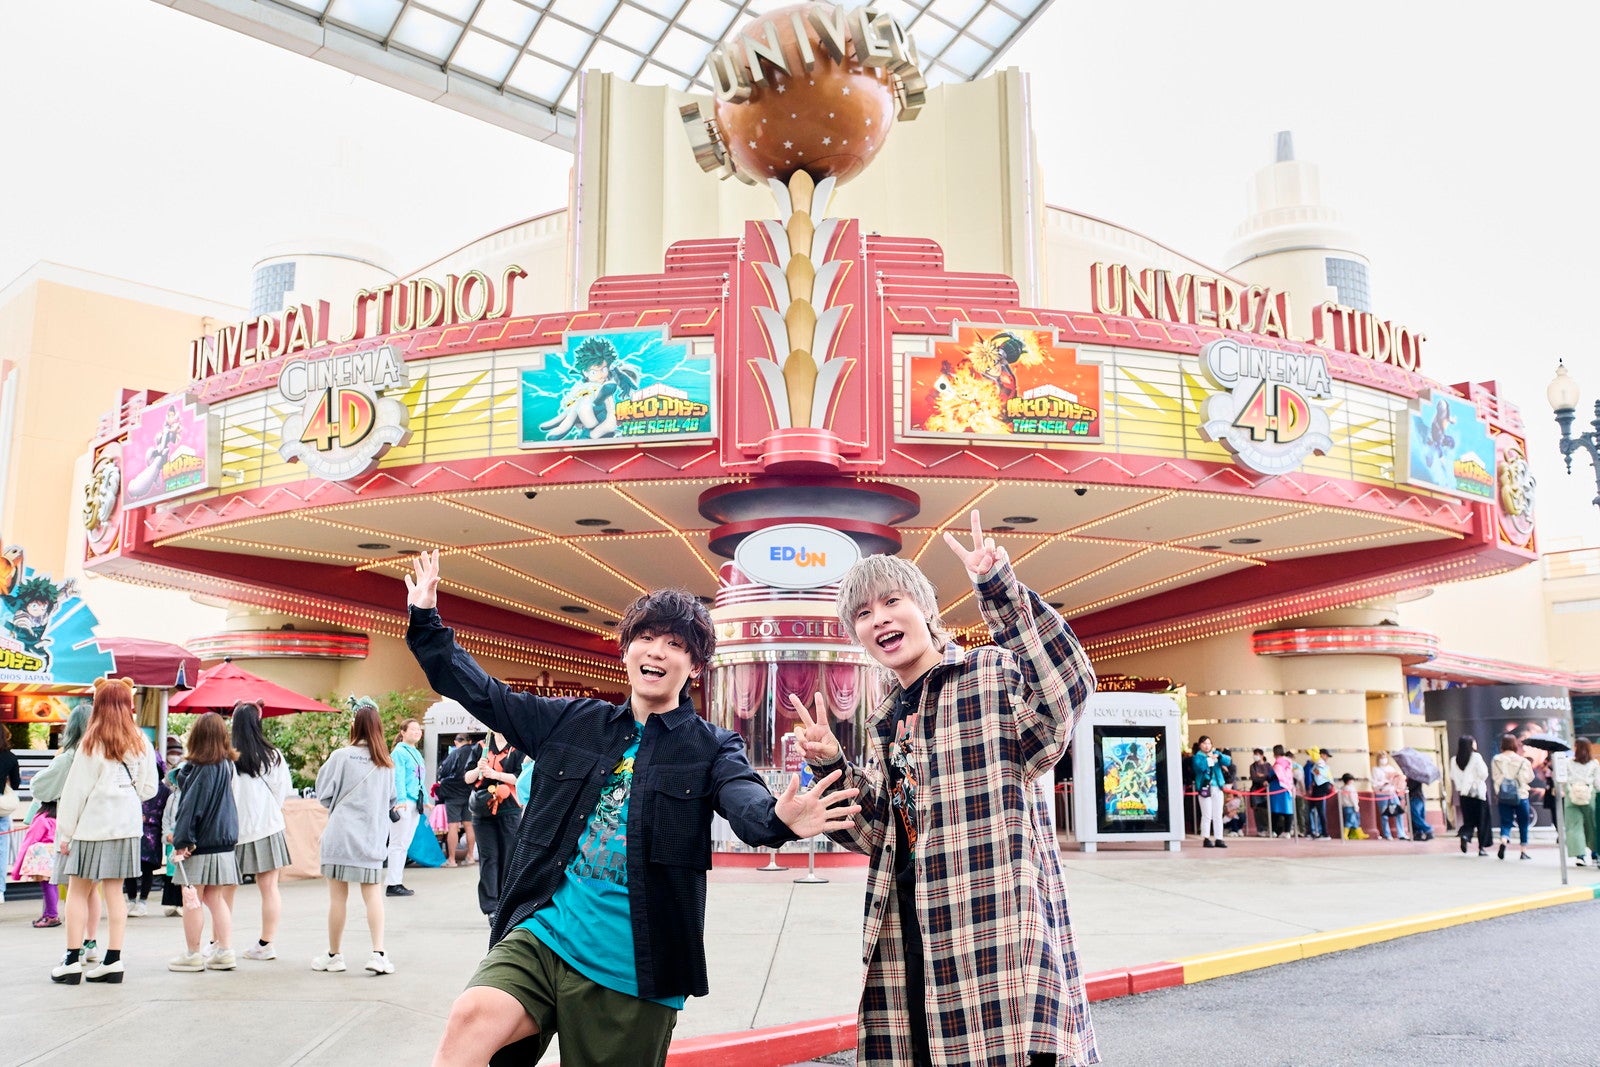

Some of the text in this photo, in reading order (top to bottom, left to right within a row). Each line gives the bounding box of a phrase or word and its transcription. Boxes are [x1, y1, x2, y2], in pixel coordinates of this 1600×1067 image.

[189, 264, 528, 381] UNIVERSAL STUDIOS
[1091, 262, 1427, 373] UNIVERSAL STUDIOS
[279, 346, 399, 402] CINEMA
[1209, 339, 1331, 393] CINEMA
[621, 417, 699, 435] THE REAL 4D
[1013, 419, 1089, 435] THE REAL 4D
[769, 546, 827, 567] EDION
[750, 622, 782, 637] BOX
[24, 673, 51, 681] JAPAN
